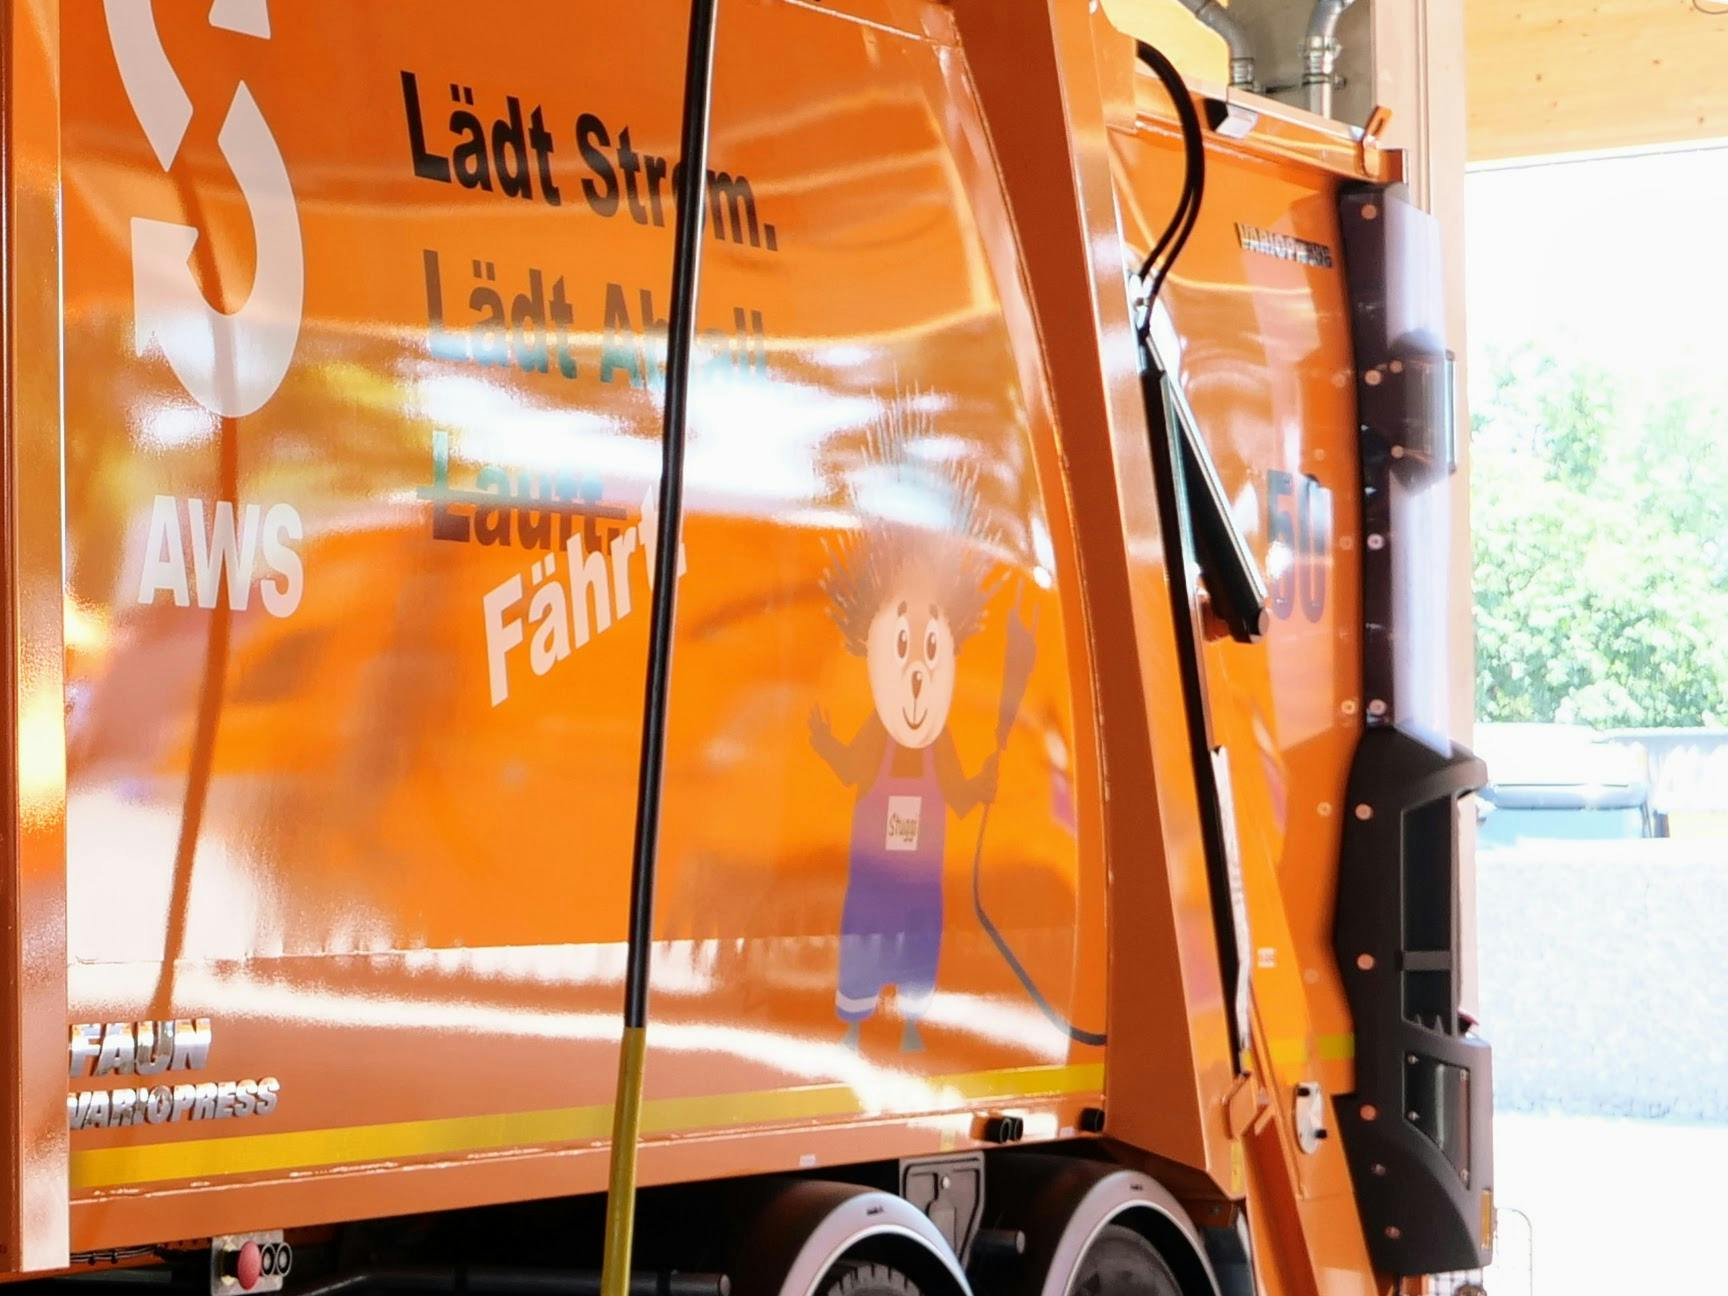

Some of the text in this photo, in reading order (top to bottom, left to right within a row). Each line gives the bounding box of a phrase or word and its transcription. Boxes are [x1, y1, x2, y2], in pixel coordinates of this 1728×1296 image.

[400, 70, 560, 207] Lädt
[422, 249, 578, 380] Lädt
[137, 495, 304, 618] AWS
[67, 1076, 280, 1129] VARIOPRESS
[69, 1018, 212, 1076] FAUN
